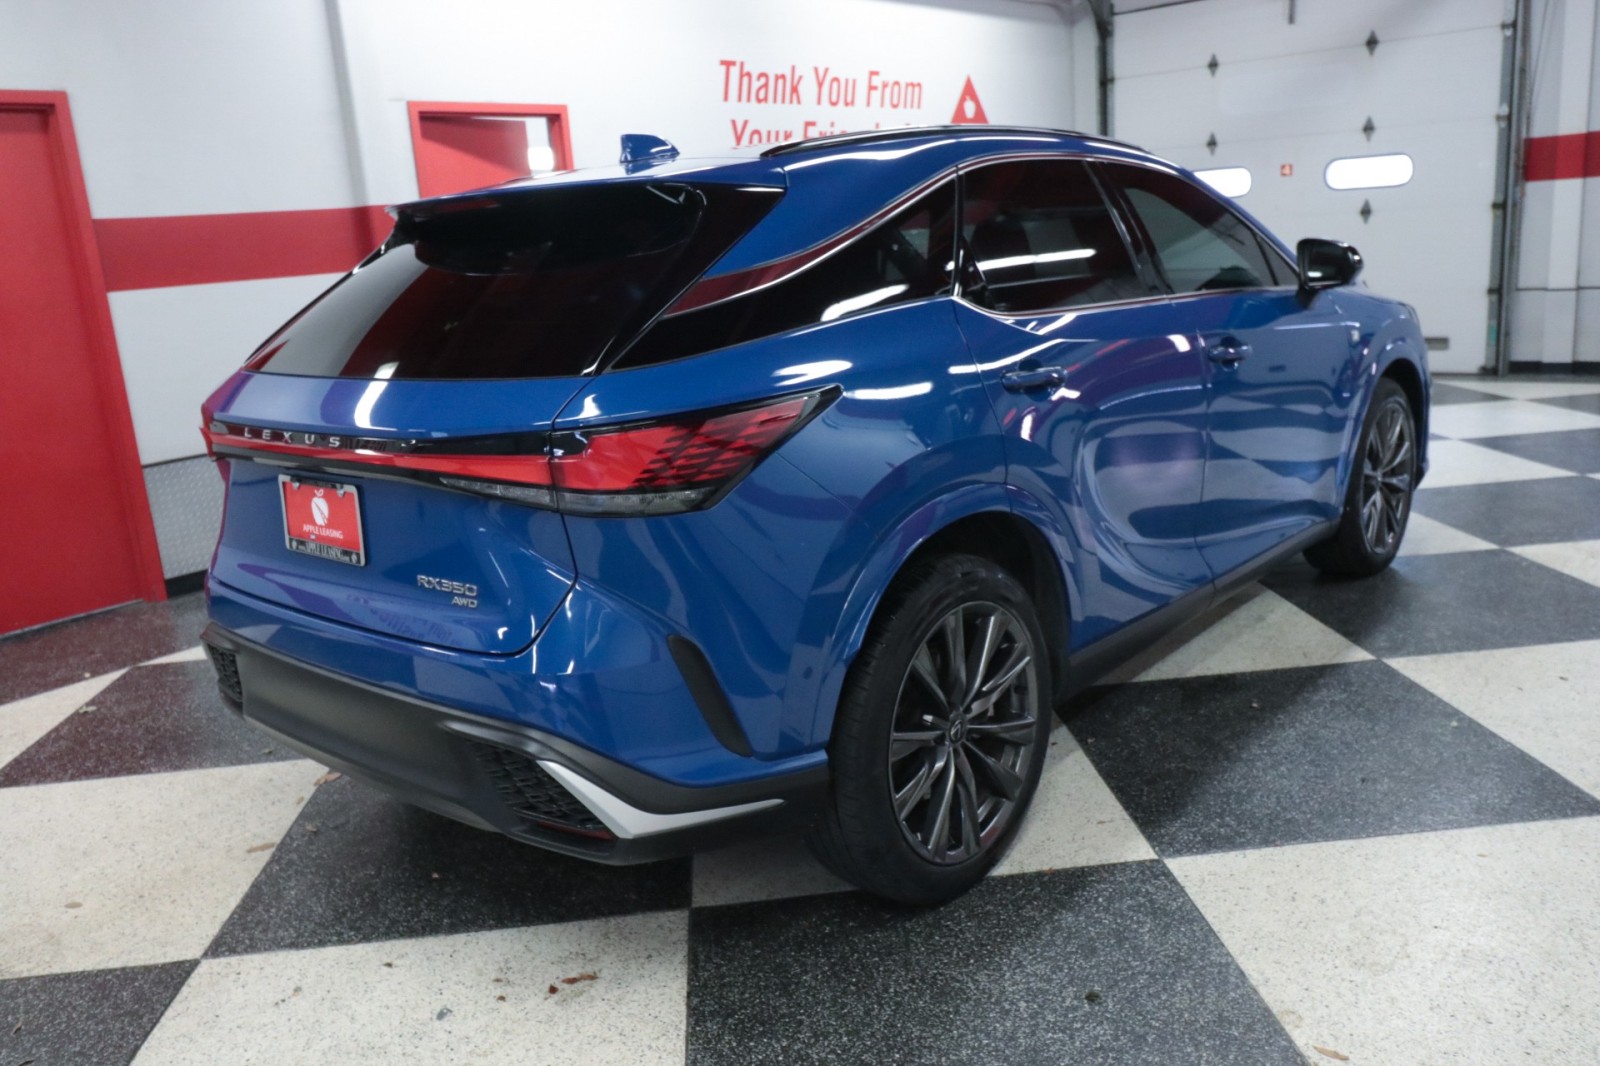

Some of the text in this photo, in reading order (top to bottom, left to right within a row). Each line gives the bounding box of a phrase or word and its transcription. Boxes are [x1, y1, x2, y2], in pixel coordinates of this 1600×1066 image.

[719, 60, 922, 109] Thank You From
[244, 426, 341, 447] LEXUS
[303, 524, 344, 540] APPLE LEASING
[417, 574, 477, 596] RX350
[451, 596, 478, 608] AWD
